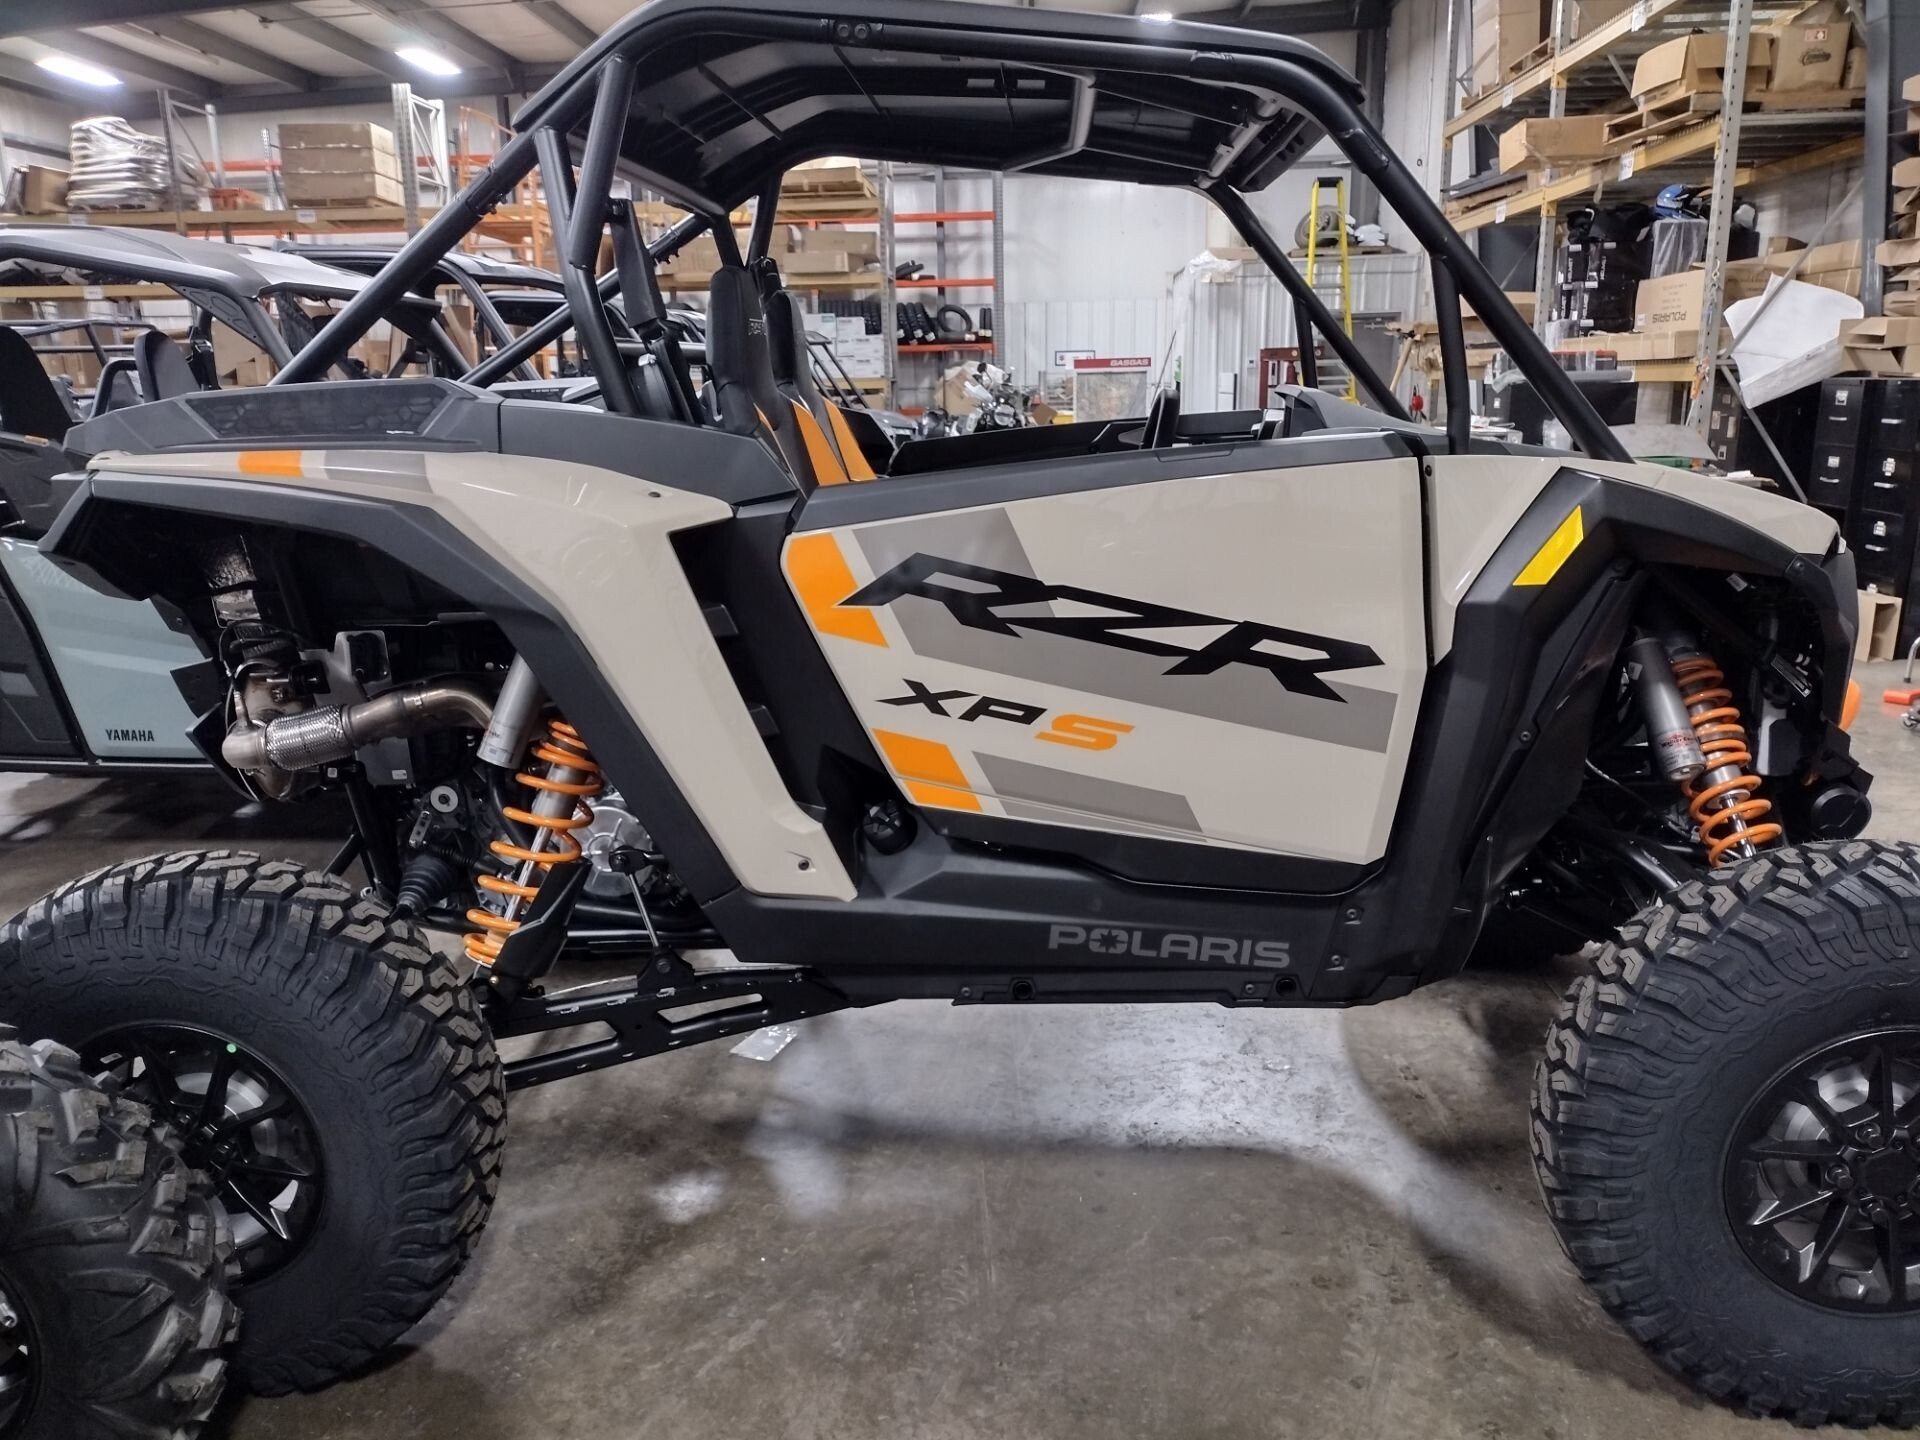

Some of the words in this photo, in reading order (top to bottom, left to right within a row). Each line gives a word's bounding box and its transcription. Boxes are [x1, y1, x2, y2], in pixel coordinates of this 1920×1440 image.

[1652, 311, 1687, 324] POLARIS
[1109, 358, 1150, 367] GASGAS
[837, 552, 1386, 704] RZR
[105, 729, 154, 742] YAMAHA
[1048, 924, 1291, 968] POLARIS
